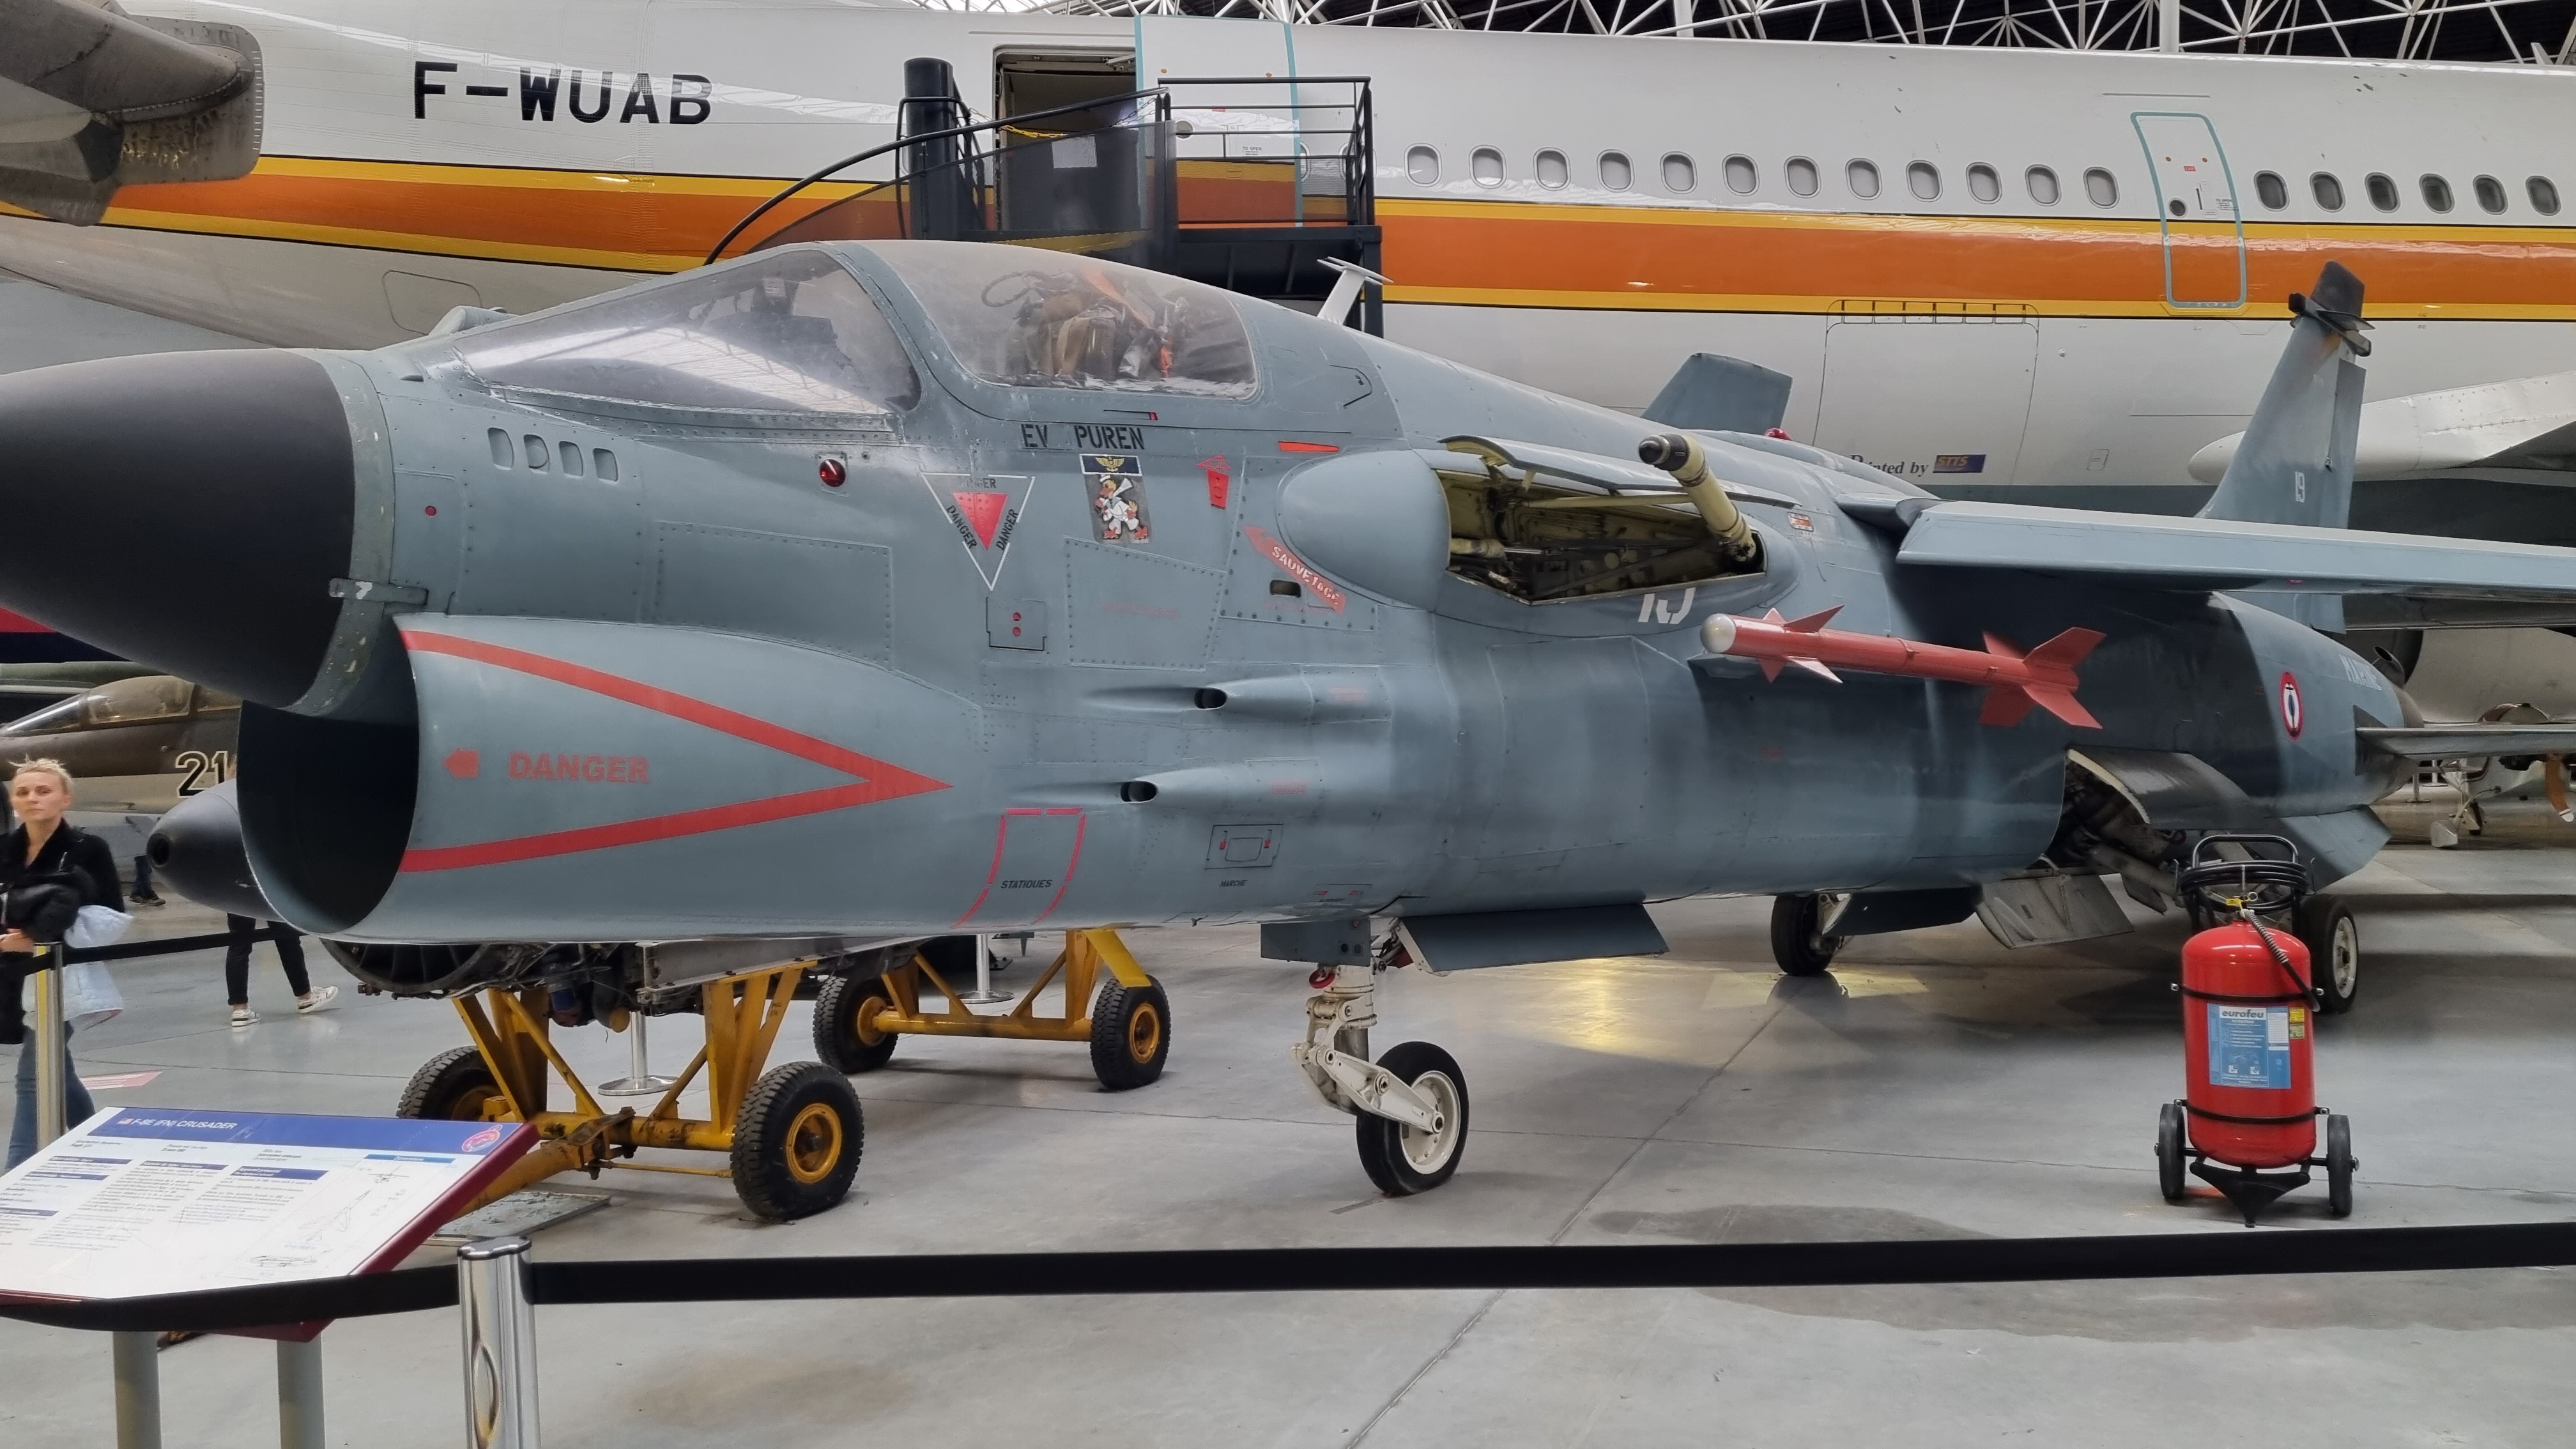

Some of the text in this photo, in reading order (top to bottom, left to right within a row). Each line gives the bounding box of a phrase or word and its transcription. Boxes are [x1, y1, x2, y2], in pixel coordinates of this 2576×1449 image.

[415, 61, 712, 125] F-WUAB
[1021, 424, 1145, 450] EV PUREN
[1910, 461, 1929, 477] by
[946, 505, 977, 549] DANGER
[995, 509, 1019, 551] DANGER
[1272, 546, 1340, 605] SAUVETAGE
[175, 750, 228, 799] 21
[509, 752, 649, 783] DANGER
[1000, 879, 1053, 889] STATIQUES
[2222, 1009, 2264, 1018] eurofeu
[176, 1120, 238, 1130] CRUSADER
